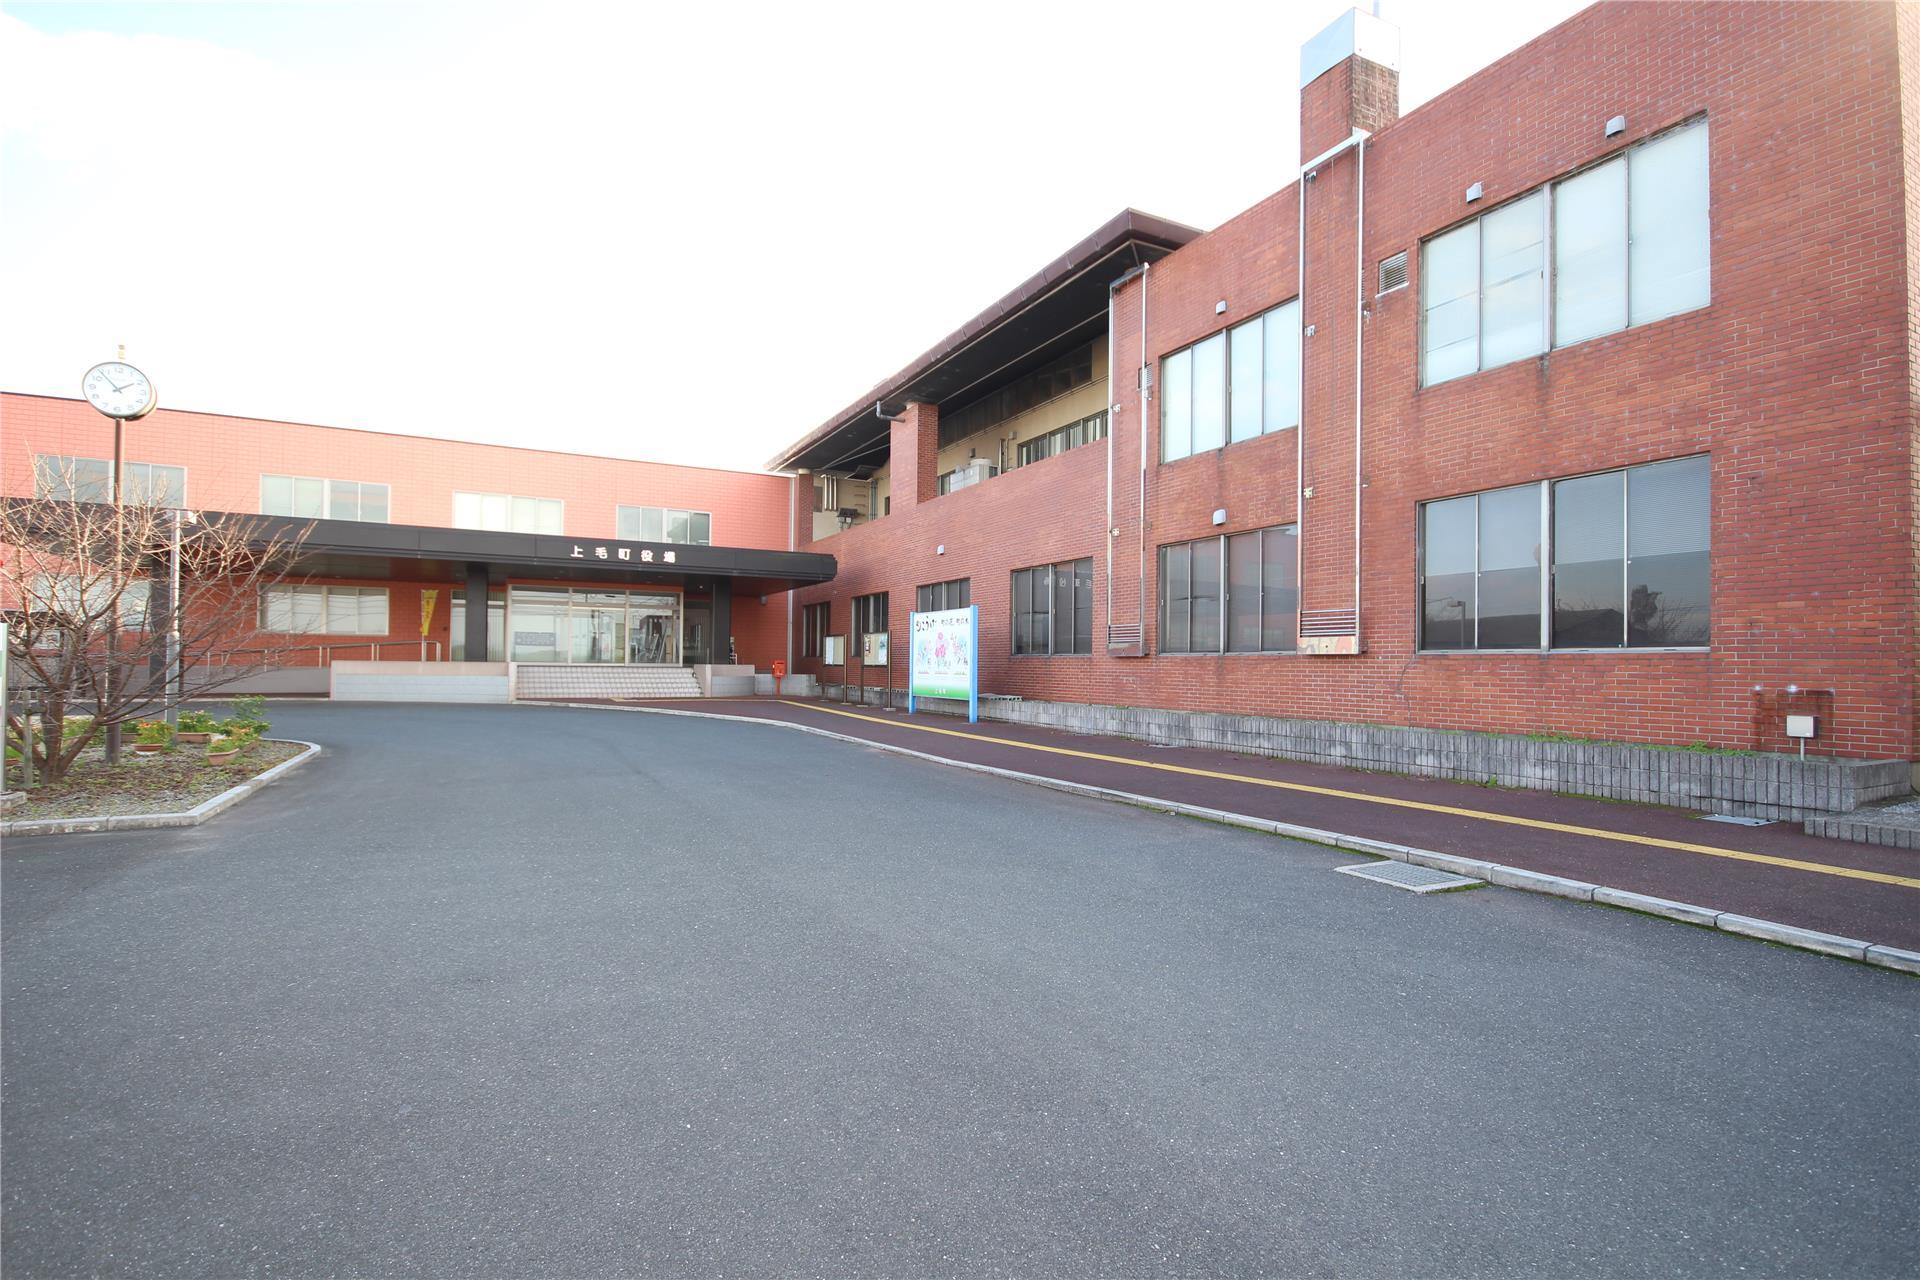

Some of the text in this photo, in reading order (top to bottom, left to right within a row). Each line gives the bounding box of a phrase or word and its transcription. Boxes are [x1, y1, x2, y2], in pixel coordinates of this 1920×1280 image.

[570, 545, 676, 563] 上毛町役場
